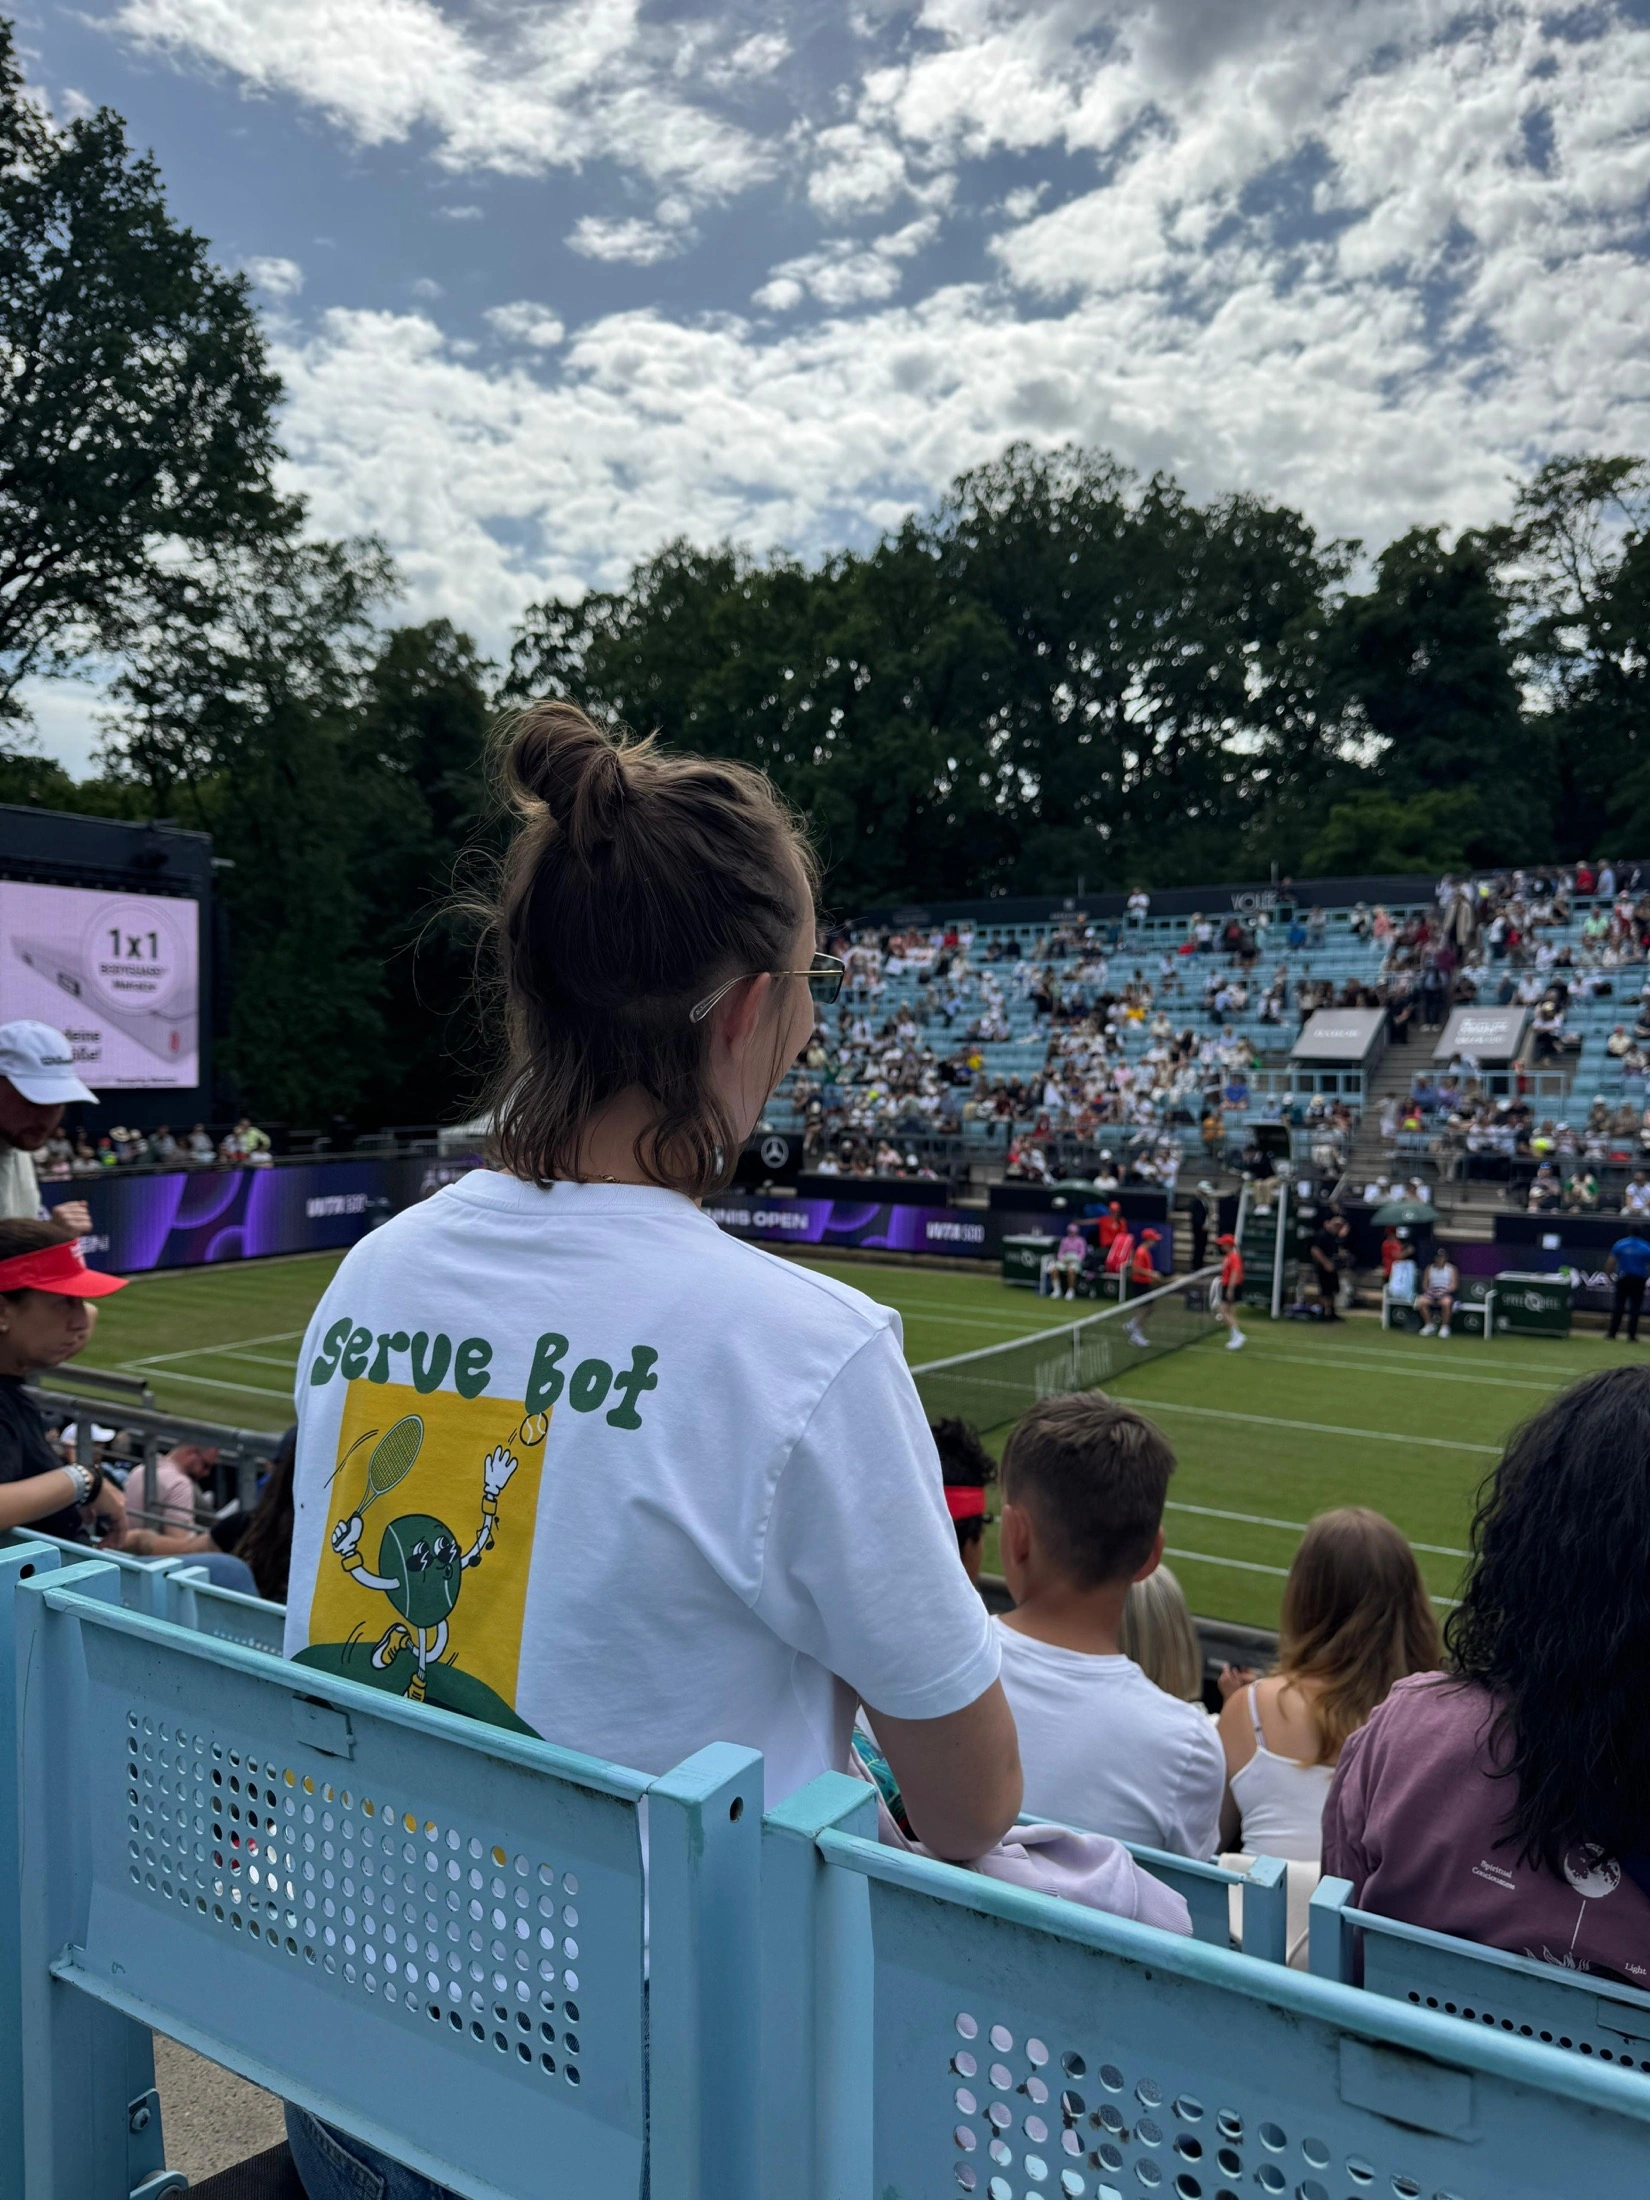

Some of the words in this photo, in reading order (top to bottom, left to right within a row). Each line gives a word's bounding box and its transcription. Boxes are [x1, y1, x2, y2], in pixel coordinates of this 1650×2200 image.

[108, 927, 158, 959] 1x1
[753, 1211, 809, 1229] OPEN
[525, 1332, 658, 1430] Bot
[1480, 1859, 1512, 1878] Spiritual
[1624, 1962, 1647, 1976] Light
